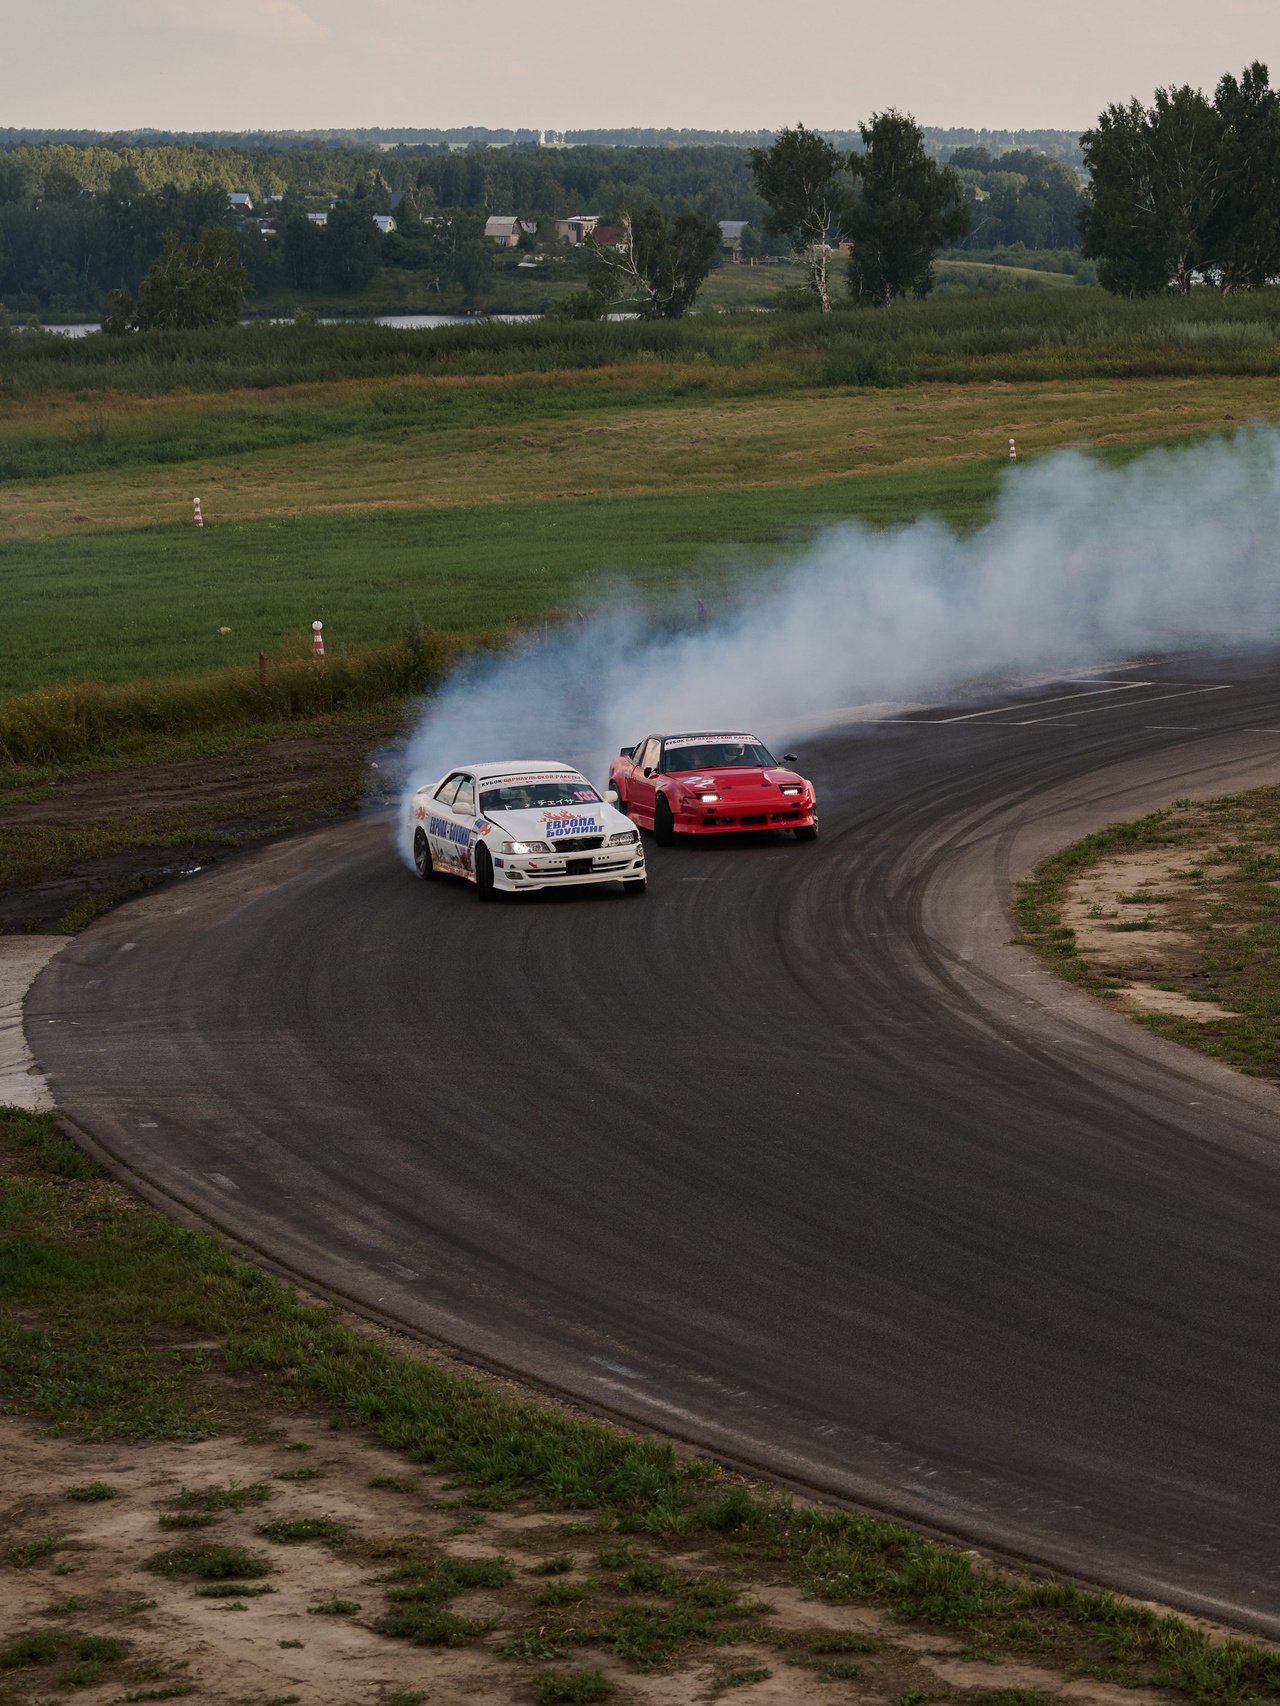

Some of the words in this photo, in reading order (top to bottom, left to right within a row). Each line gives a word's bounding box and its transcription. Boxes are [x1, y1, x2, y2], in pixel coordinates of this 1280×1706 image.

[481, 779, 502, 787] КУБОК
[683, 776, 714, 788] 22
[573, 790, 598, 801] 133
[546, 817, 595, 830] ЕВРОПА
[546, 825, 605, 838] БОУЛИНГ
